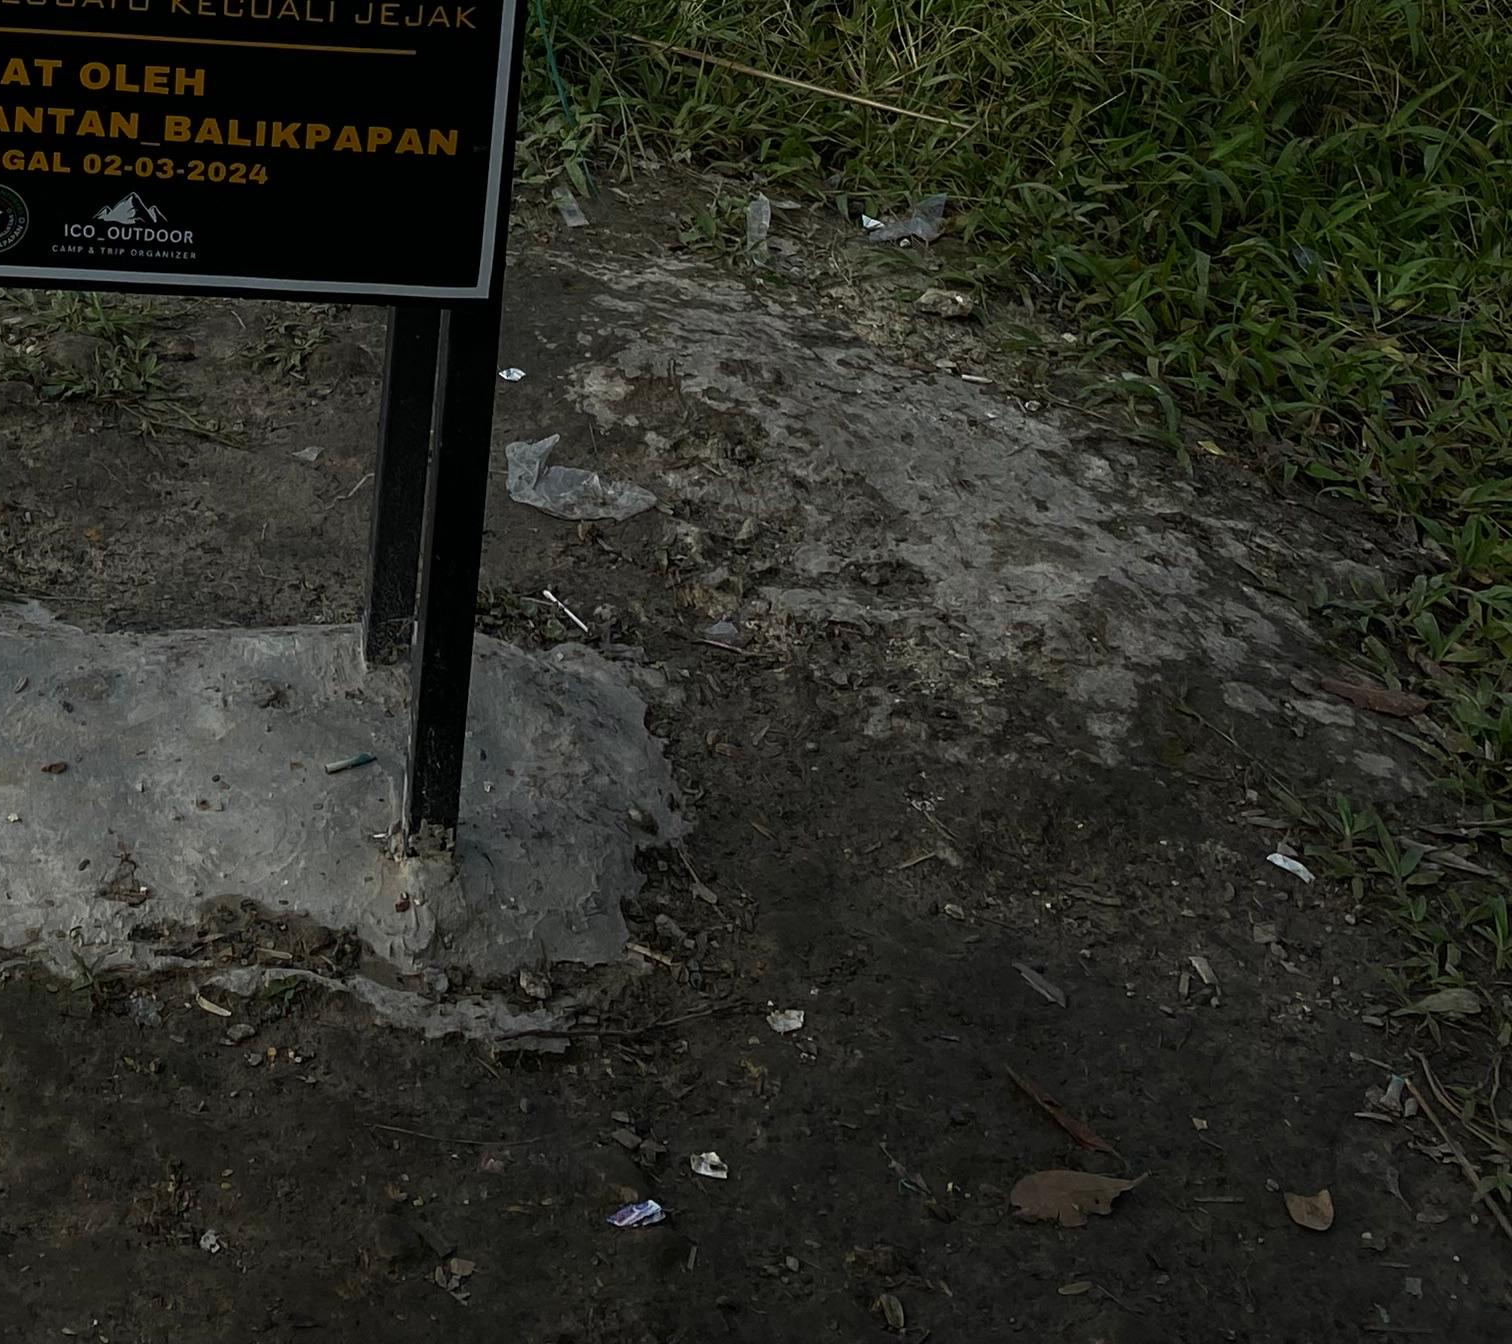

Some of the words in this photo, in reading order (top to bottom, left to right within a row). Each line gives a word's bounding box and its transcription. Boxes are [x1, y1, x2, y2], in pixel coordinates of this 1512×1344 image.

[355, 3, 475, 28] JEJAK
[80, 62, 205, 96] OLEH
[84, 154, 268, 184] 02-03-2024
[64, 223, 194, 243] ICO_OUTDOOR
[101, 247, 124, 255] TRIP
[131, 249, 195, 259] ORGANIZER
